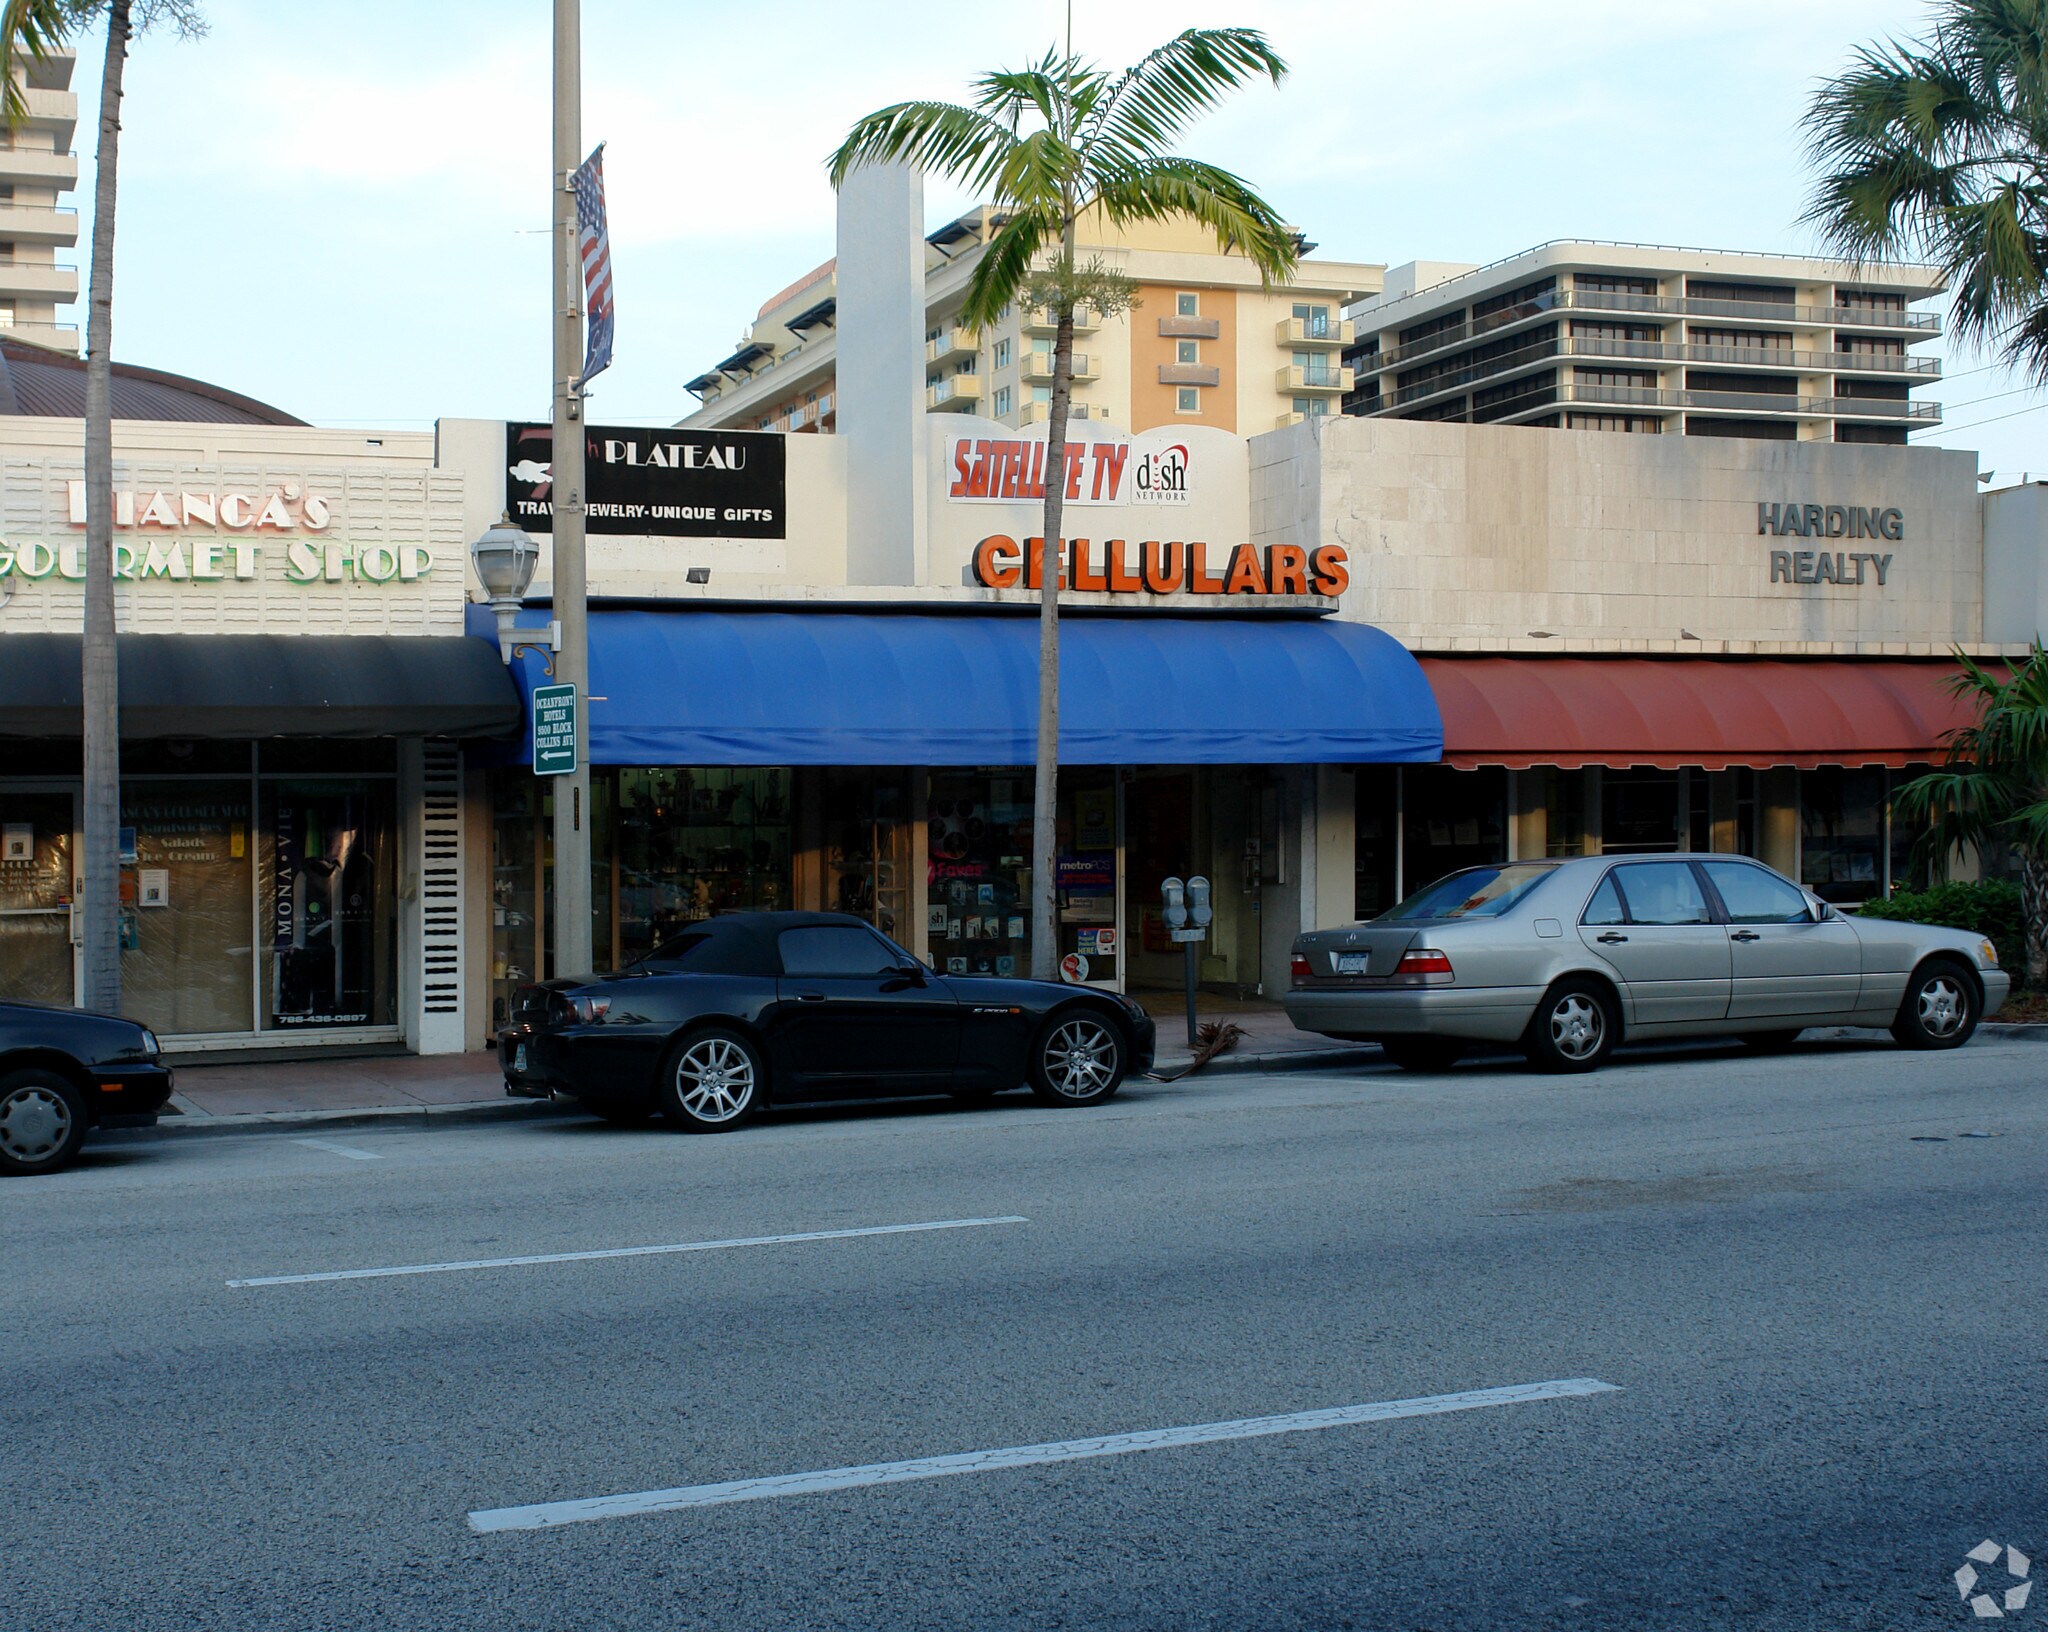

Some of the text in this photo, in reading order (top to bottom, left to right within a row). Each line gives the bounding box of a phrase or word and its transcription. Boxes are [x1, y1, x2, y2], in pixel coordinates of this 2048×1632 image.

[605, 439, 746, 471] PLATEAU
[950, 439, 1129, 501] SATELLTE TV
[1137, 453, 1186, 491] dish
[1136, 491, 1186, 501] NETWORK
[723, 508, 773, 522] GIFTS
[1758, 502, 1904, 540] HARDING
[287, 542, 435, 581] SHOP
[971, 534, 1350, 597] CELLULARS
[1770, 550, 1893, 585] REALTY
[536, 695, 573, 709] OCEANFRONT
[543, 709, 566, 721] HOTELS
[552, 722, 572, 734] BLOCK
[536, 735, 573, 748] COLLINS AVE
[161, 837, 205, 848] Salads
[168, 851, 216, 862] Cream
